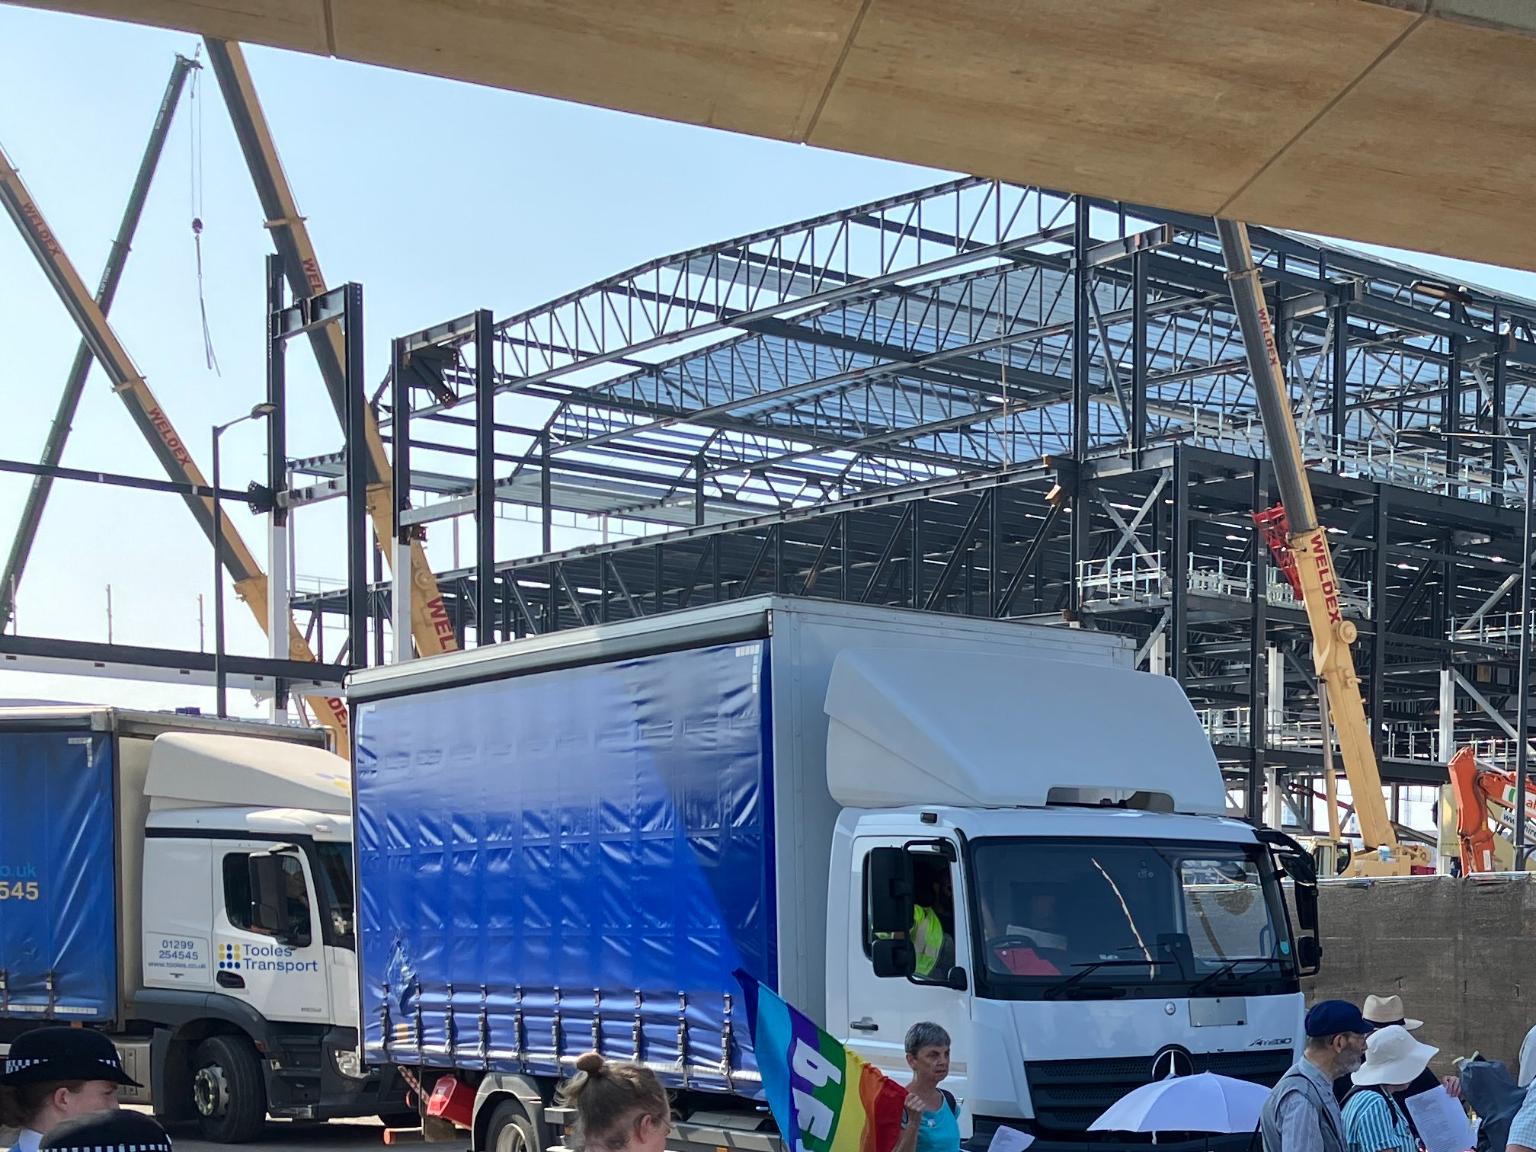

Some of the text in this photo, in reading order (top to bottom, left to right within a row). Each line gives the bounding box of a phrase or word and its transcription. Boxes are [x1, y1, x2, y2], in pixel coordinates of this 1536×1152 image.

[24, 201, 62, 257] WELDEX
[1258, 307, 1278, 366] WELDEX
[147, 406, 192, 465] WELDEX
[1310, 534, 1341, 625] WELDEX
[426, 596, 459, 653] WEL
[158, 950, 199, 961] 254545
[162, 939, 194, 949] 01299
[243, 944, 293, 958] Tooles
[243, 958, 319, 973] Transport
